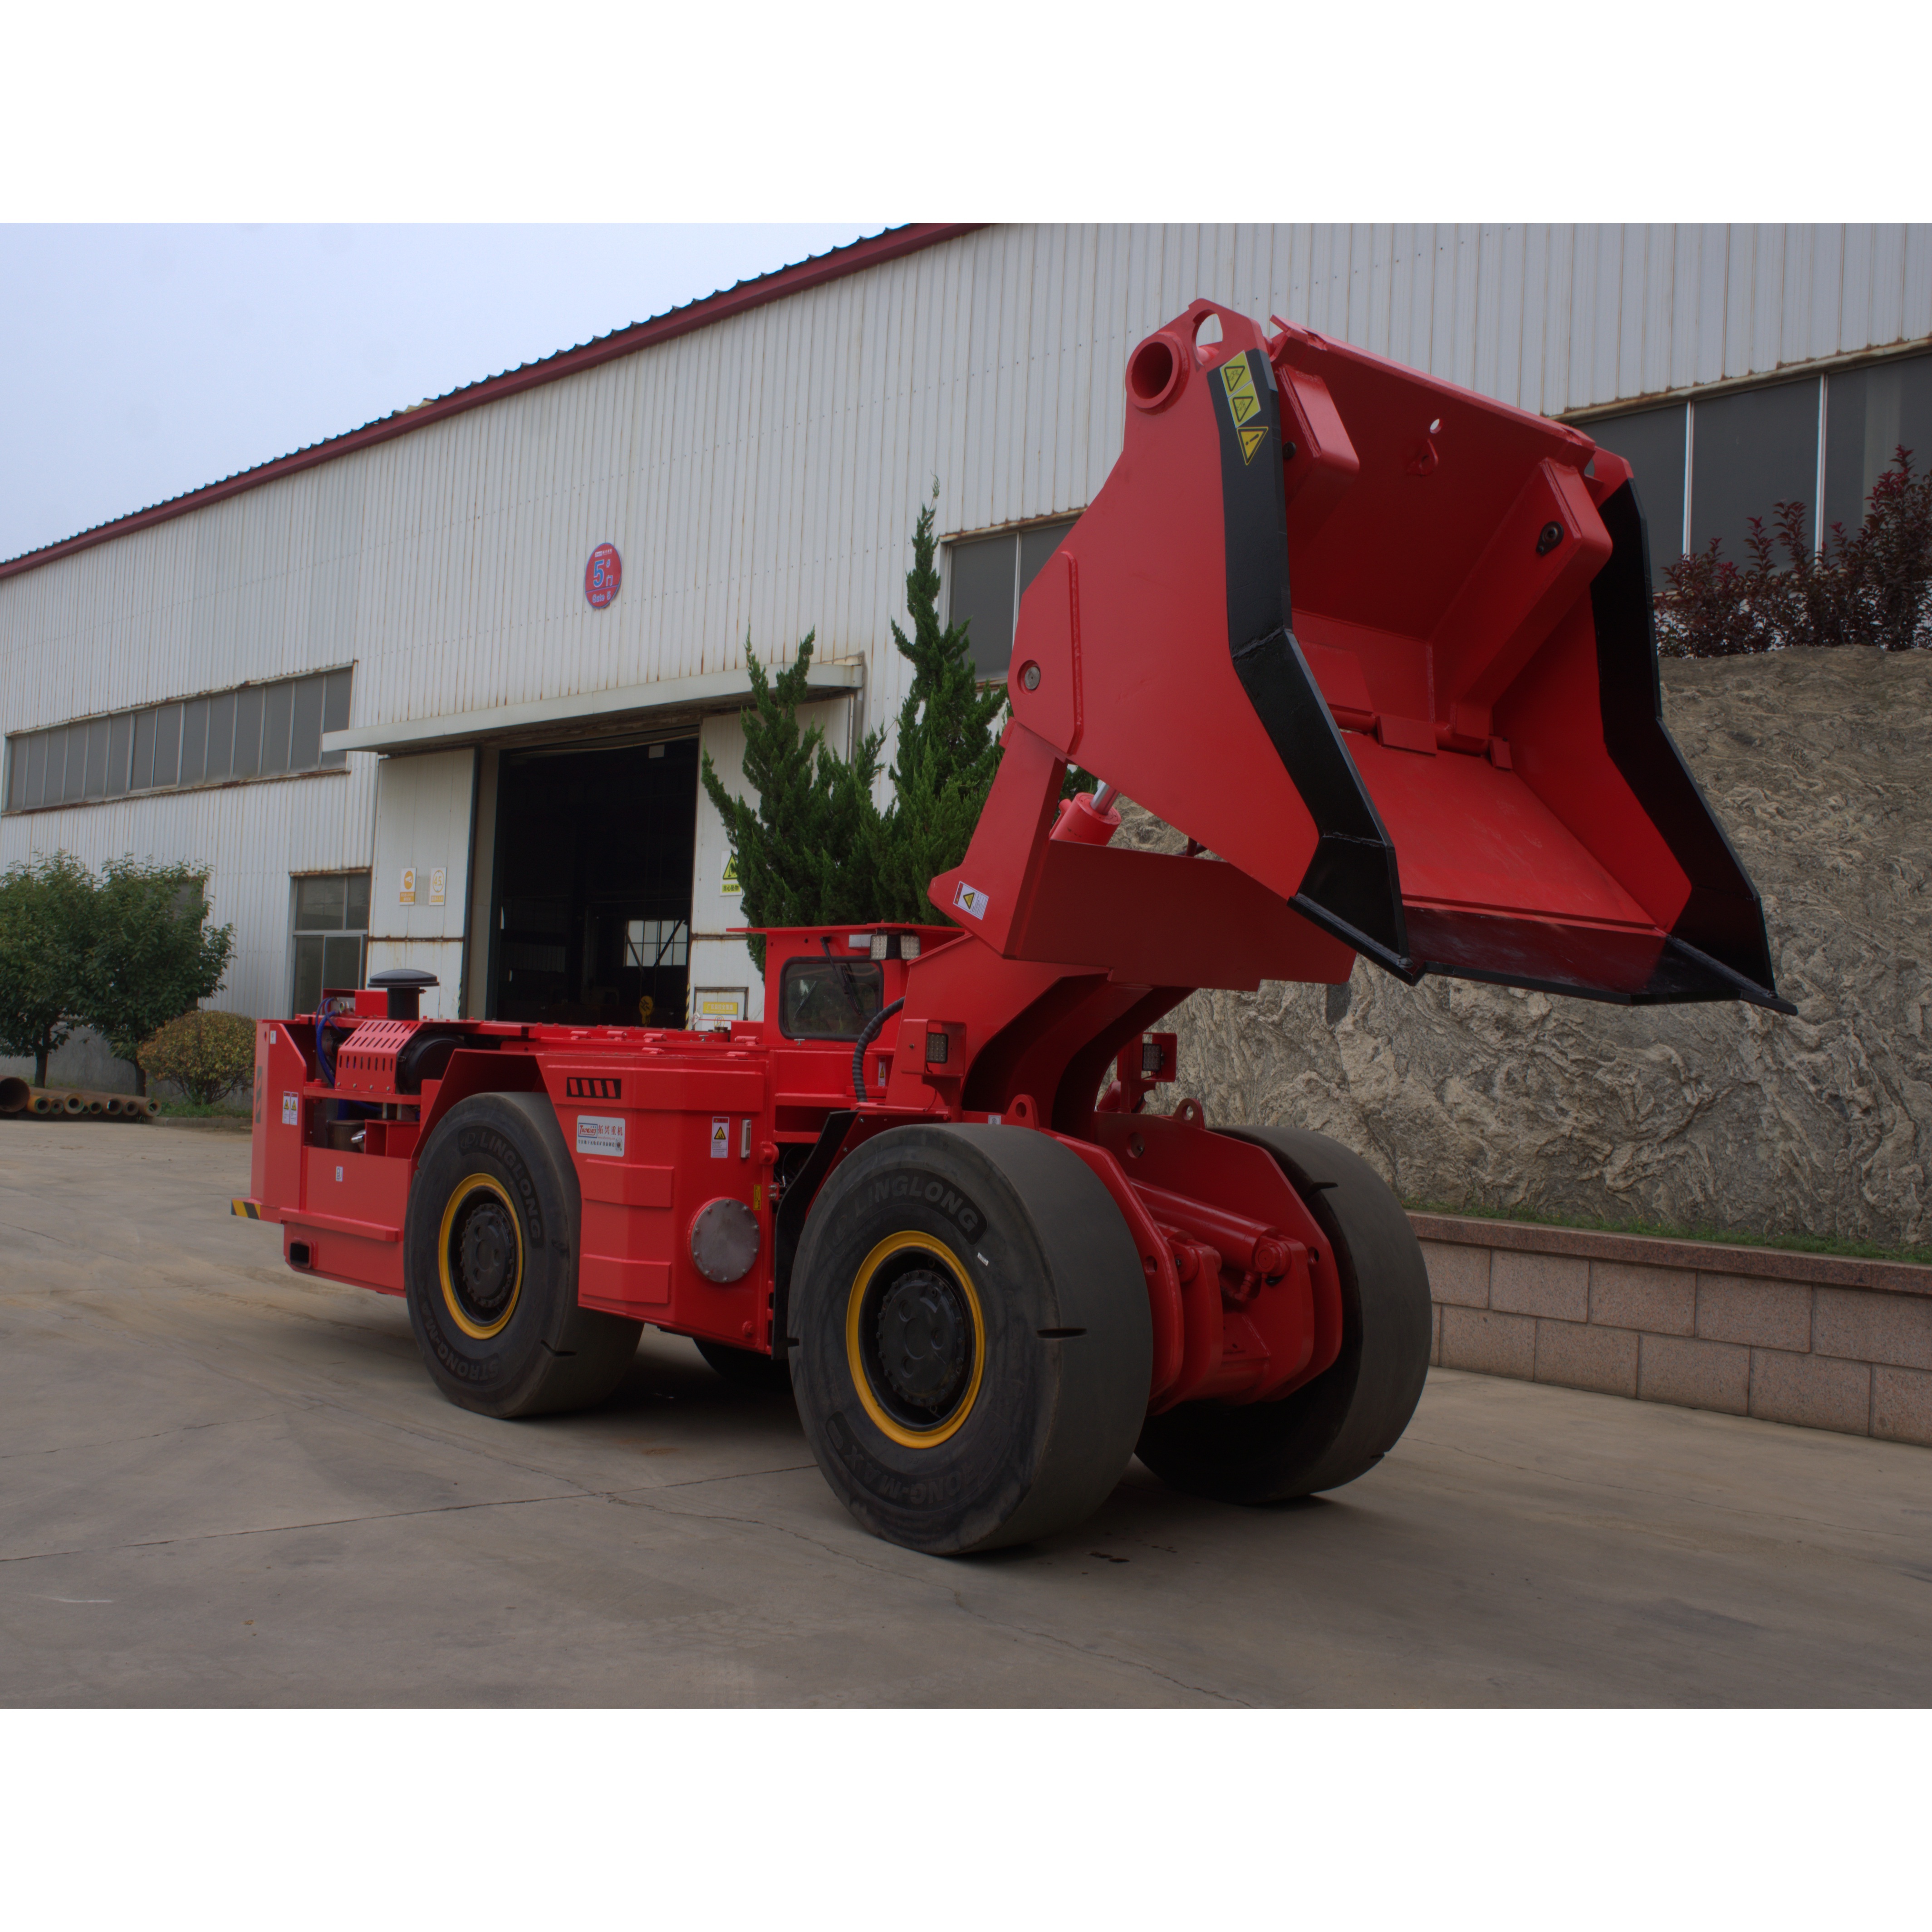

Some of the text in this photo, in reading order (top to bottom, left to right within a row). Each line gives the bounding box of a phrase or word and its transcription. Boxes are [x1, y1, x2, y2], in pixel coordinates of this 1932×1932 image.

[592, 591, 611, 603] Gate 5
[598, 1125, 623, 1136] 拓兴重机
[480, 1132, 541, 1239] LINGLONG
[853, 1175, 979, 1233] LINGLONG
[417, 1282, 499, 1381] STRONG-MAX
[843, 1422, 1002, 1505] STRONG-MAX
